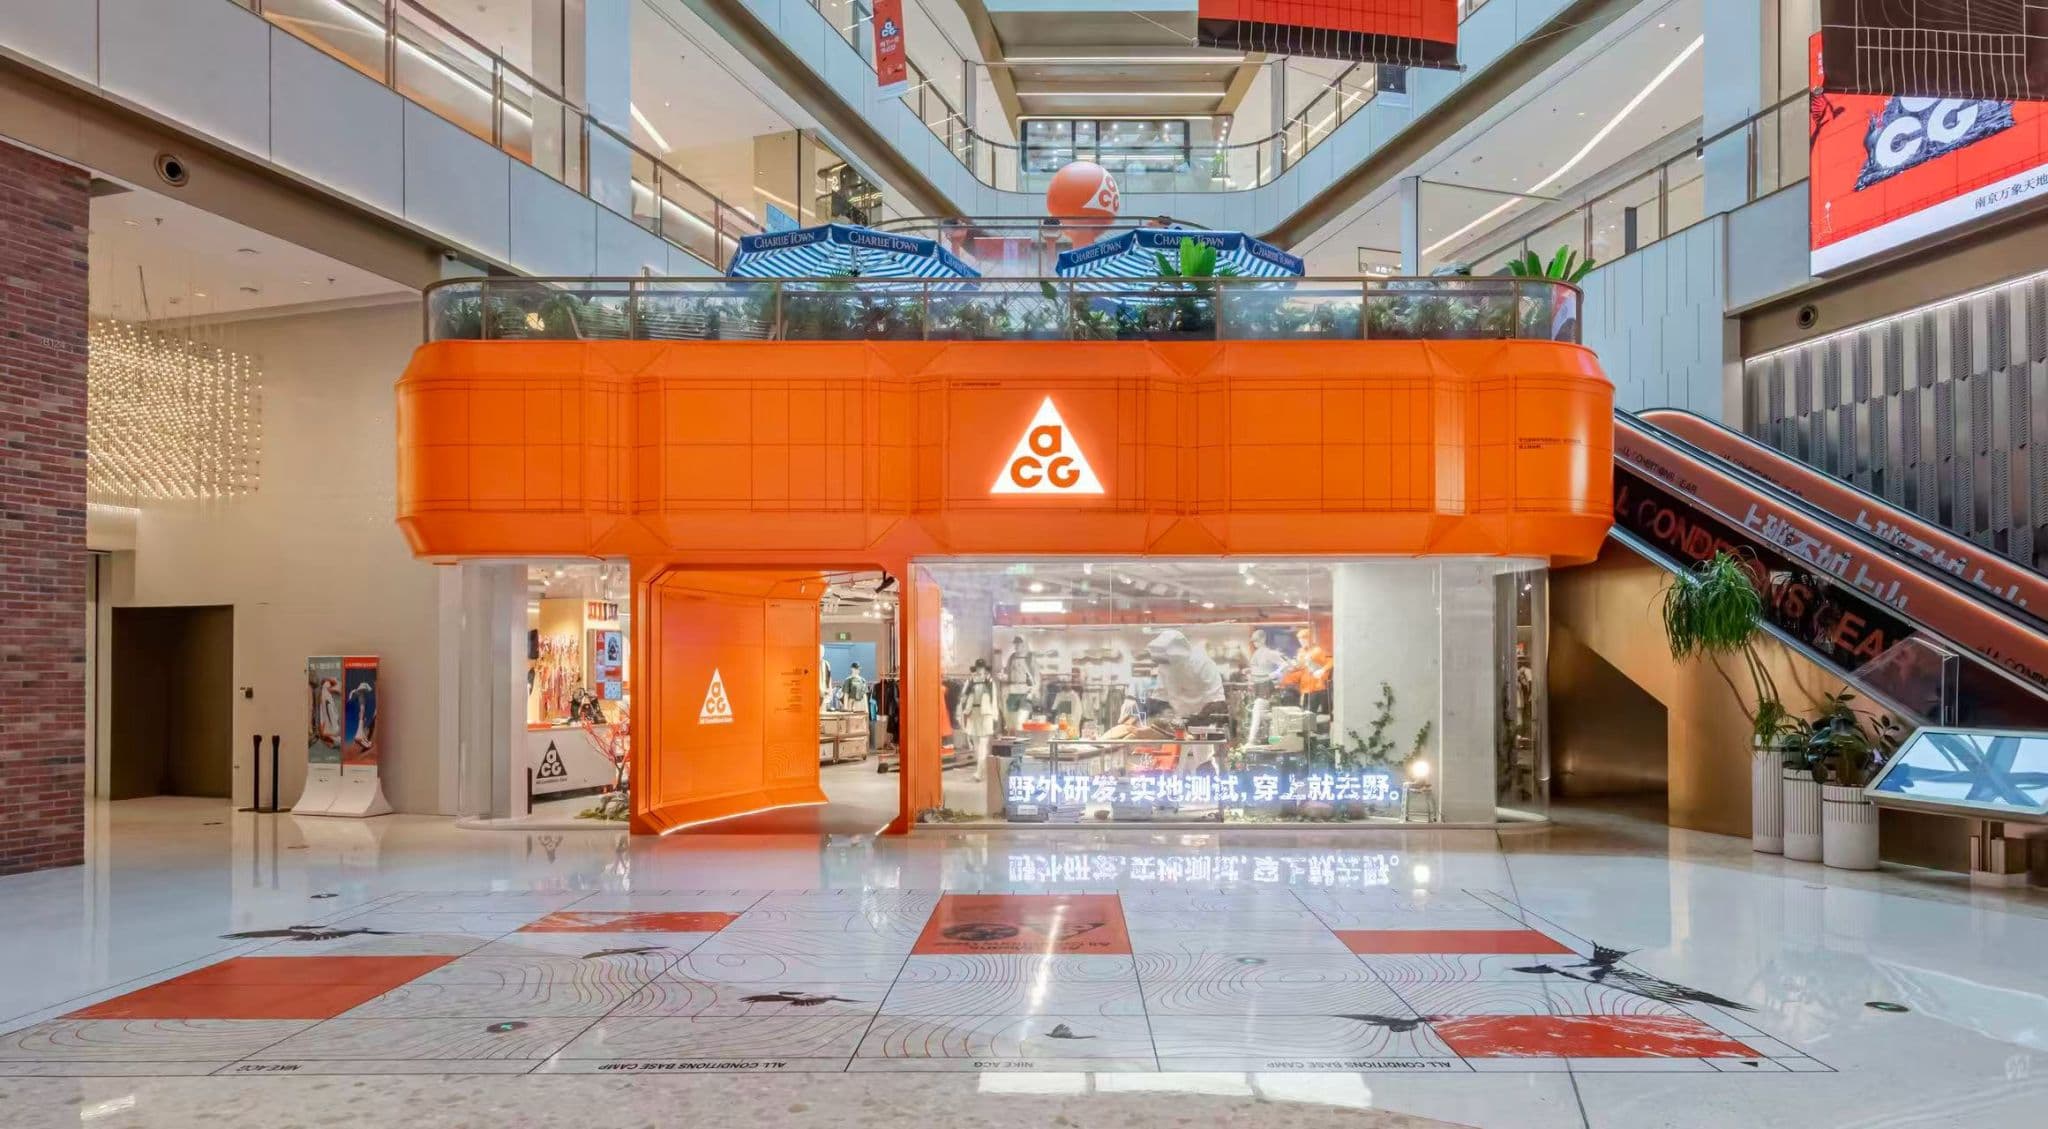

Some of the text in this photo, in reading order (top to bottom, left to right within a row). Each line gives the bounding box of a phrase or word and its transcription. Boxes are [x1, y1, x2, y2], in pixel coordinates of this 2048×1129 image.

[1876, 96, 1979, 168] CG
[1975, 173, 2048, 210] 南京万象天地
[754, 231, 815, 249] CHARLIE TOWN
[850, 231, 919, 252] CHARLIE TOWN
[598, 1062, 639, 1071] CAMP
[640, 1062, 676, 1070] BASE
[678, 1062, 759, 1070] CONDITIONS
[1345, 1061, 1426, 1069] CONDITIONS
